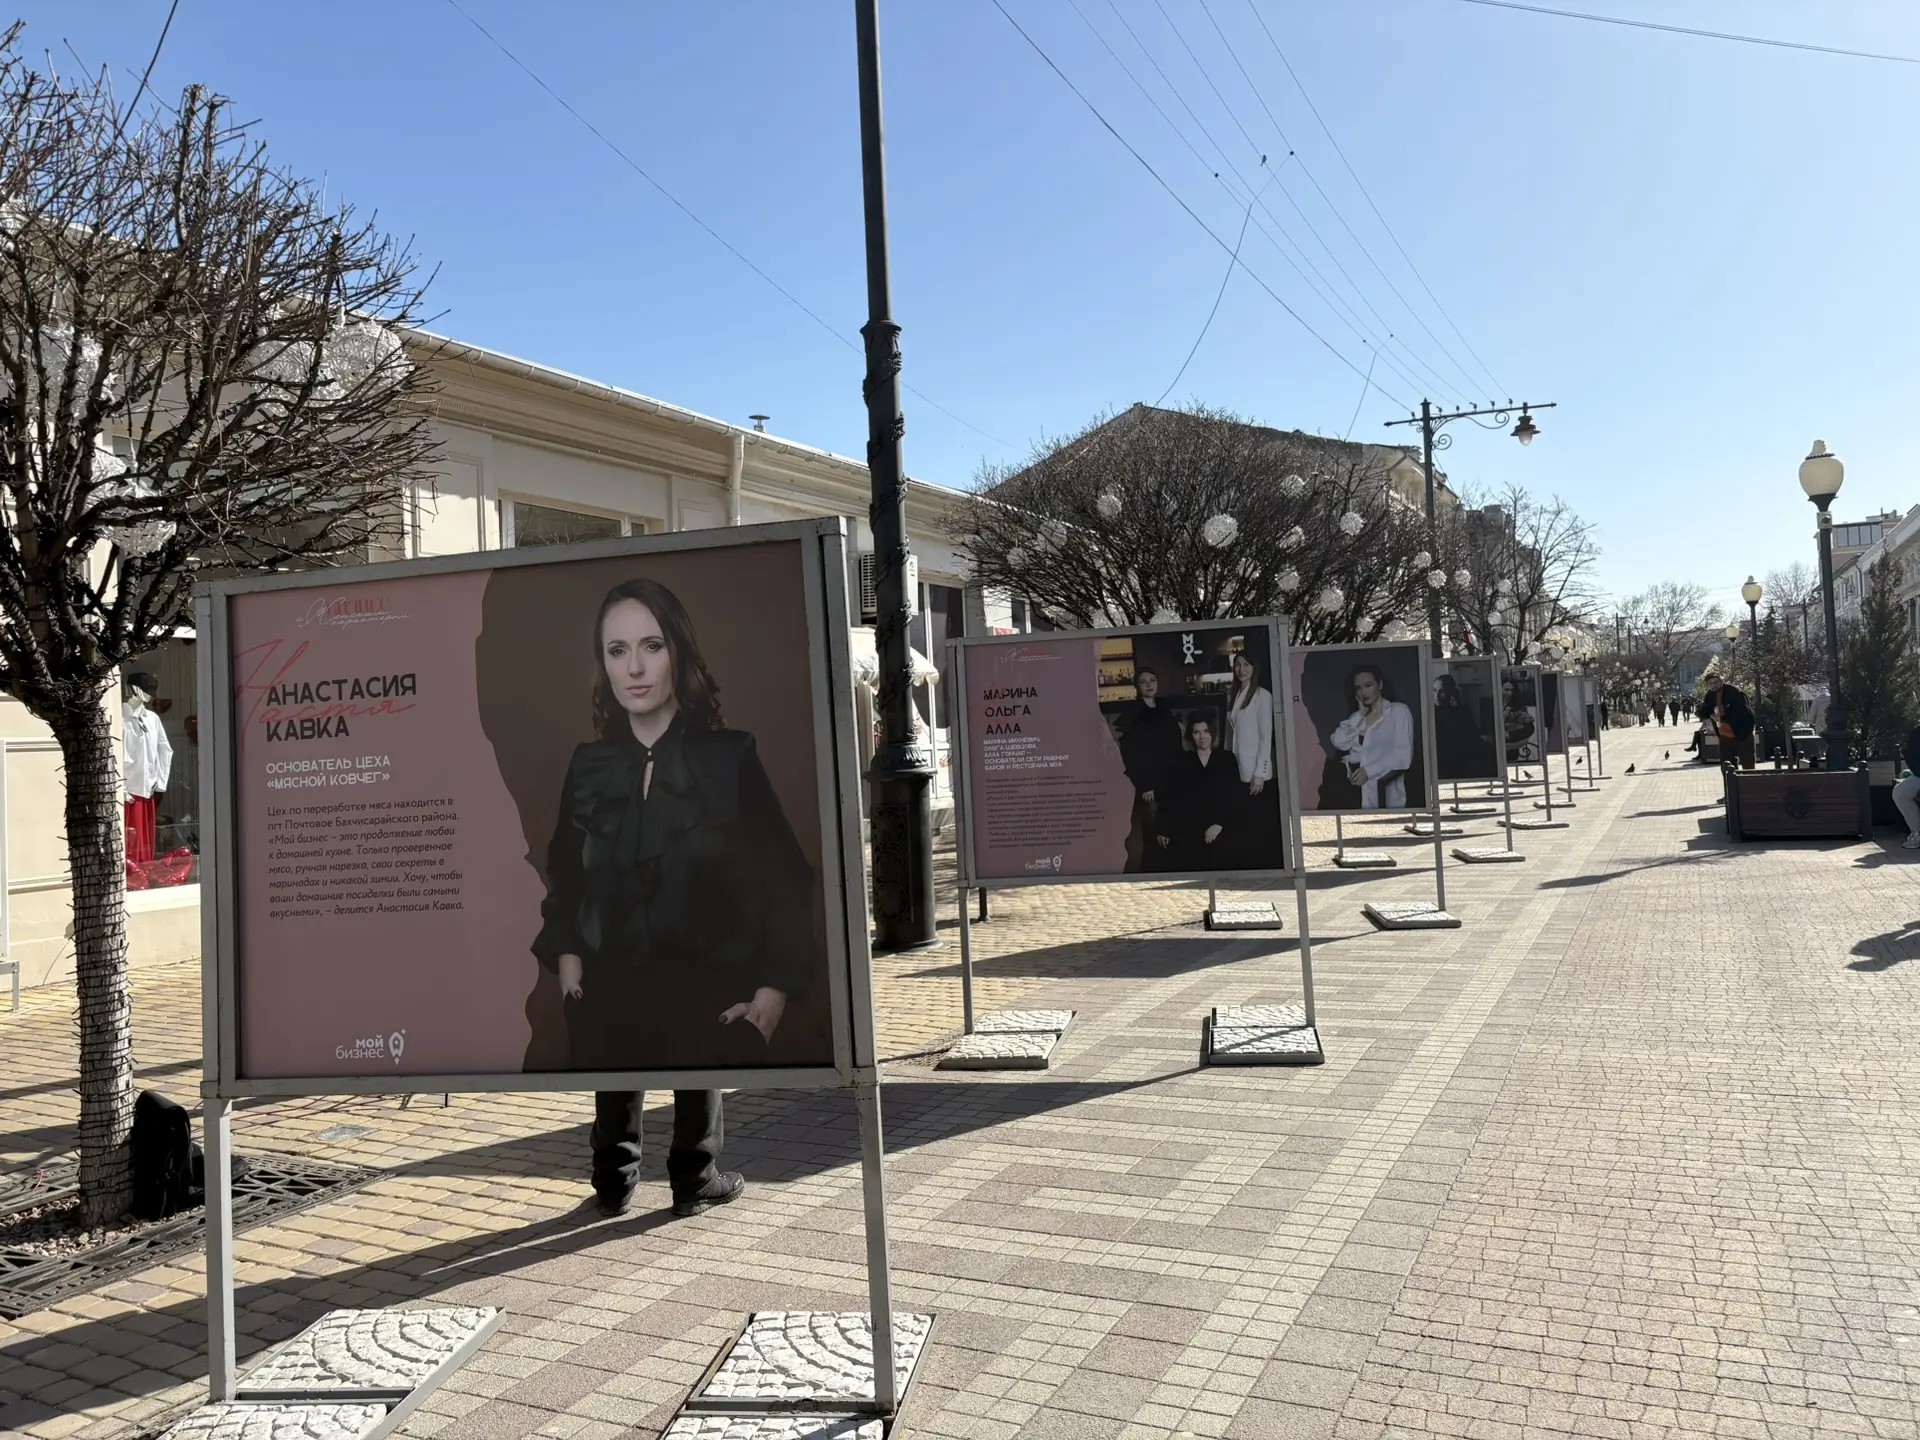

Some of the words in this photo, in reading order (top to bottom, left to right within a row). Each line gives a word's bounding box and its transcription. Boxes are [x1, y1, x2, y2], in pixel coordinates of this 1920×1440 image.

[266, 673, 416, 706] АНАСТАСИЯ
[984, 687, 1038, 700] МАРИНА
[985, 705, 1031, 717] ОЛЬГА
[266, 716, 350, 742] КАВКА
[986, 723, 1021, 735] АЛЛА
[266, 758, 351, 774] ОСНОВАТЕЛЬ
[356, 755, 391, 770] ЦЕХА
[267, 774, 326, 789] «МЯСНОЙ
[330, 772, 390, 786] КОВЧЕГ»
[268, 806, 287, 816] Цех
[290, 807, 301, 815] по
[304, 803, 367, 815] переработке
[369, 802, 392, 810] мяса
[394, 799, 445, 810] находится
[268, 823, 283, 831] пгт
[285, 819, 333, 829] Почтовое
[335, 814, 419, 827] Бахчисарайского
[422, 812, 459, 823] района.
[269, 835, 295, 845] «Мой
[297, 834, 328, 843] бизнес
[360, 829, 423, 842] продолжение
[424, 826, 455, 837] любви
[276, 847, 324, 859] домашней
[326, 847, 354, 857] кухне.
[357, 844, 389, 854] Только
[391, 842, 453, 853] проверенное
[269, 866, 293, 874] мясо,
[295, 864, 327, 874] ручная
[329, 861, 369, 871] нарезка,
[371, 861, 393, 869] свои
[395, 859, 437, 868] секреты
[269, 878, 320, 889] маринадах
[330, 874, 368, 885] никакой
[370, 876, 399, 884] химии.
[403, 872, 428, 883] Хочу,
[430, 871, 464, 881] чтобы
[270, 895, 294, 903] ваши
[296, 892, 344, 902] домашние
[346, 889, 394, 900] посиделки
[397, 888, 421, 897] были
[422, 887, 460, 896] самыми
[270, 908, 323, 919] вкусными»,
[334, 904, 373, 915] делится
[376, 902, 430, 913] Анастасия
[432, 901, 464, 911] Кавка.
[356, 1034, 384, 1048] мой
[336, 1045, 384, 1059] бизнес
